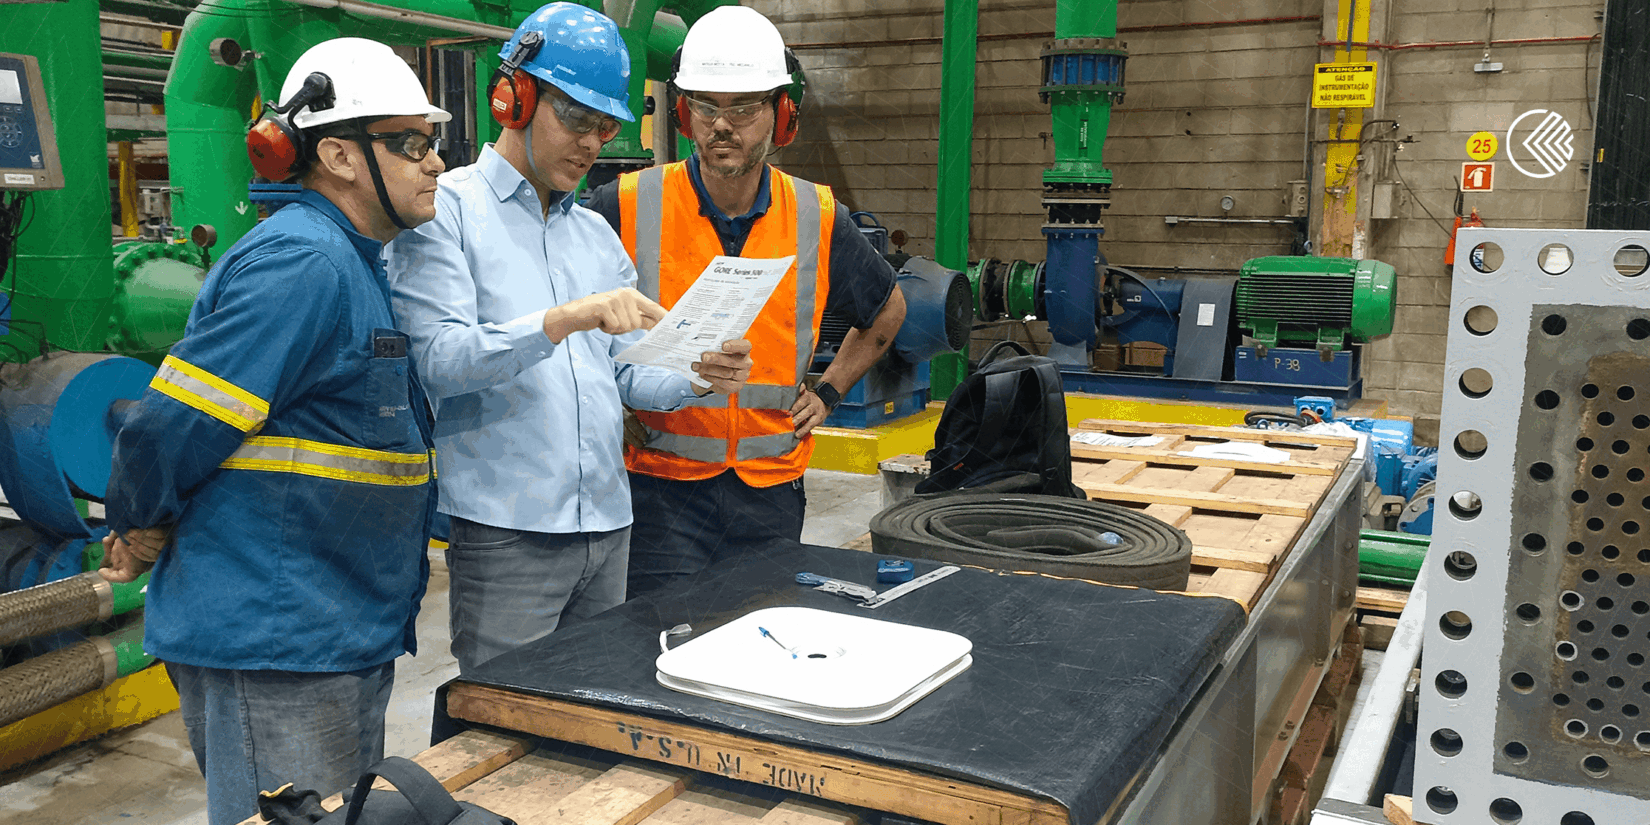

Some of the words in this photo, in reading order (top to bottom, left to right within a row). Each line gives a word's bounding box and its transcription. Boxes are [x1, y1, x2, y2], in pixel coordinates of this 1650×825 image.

[1320, 93, 1332, 101] NÃO
[1472, 138, 1491, 153] 25
[714, 266, 733, 274] GORE
[1274, 357, 1301, 372] P-38
[762, 762, 826, 796] MADE
